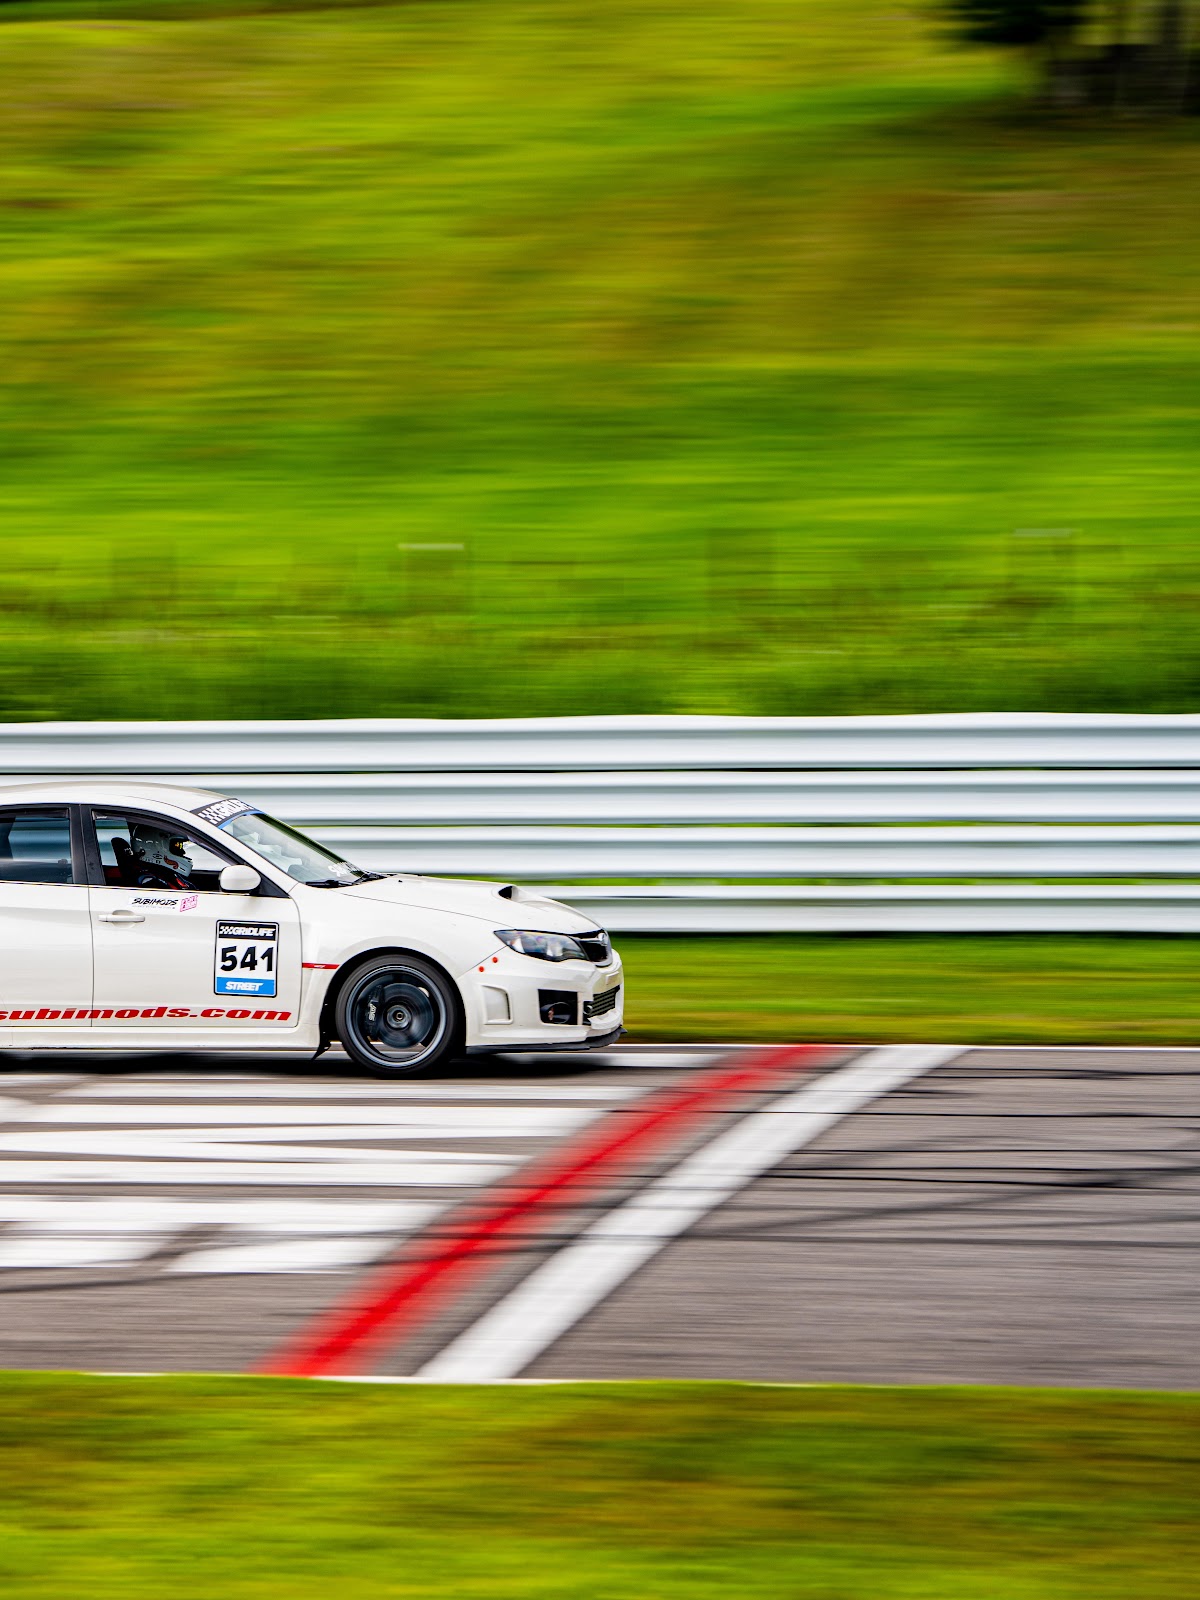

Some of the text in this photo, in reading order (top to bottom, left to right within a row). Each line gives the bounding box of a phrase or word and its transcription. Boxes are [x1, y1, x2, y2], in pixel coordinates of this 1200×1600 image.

[131, 897, 179, 906] SUBIMODS
[231, 926, 276, 937] GRIDLIFE
[220, 945, 274, 972] 541
[225, 981, 265, 992] STREET
